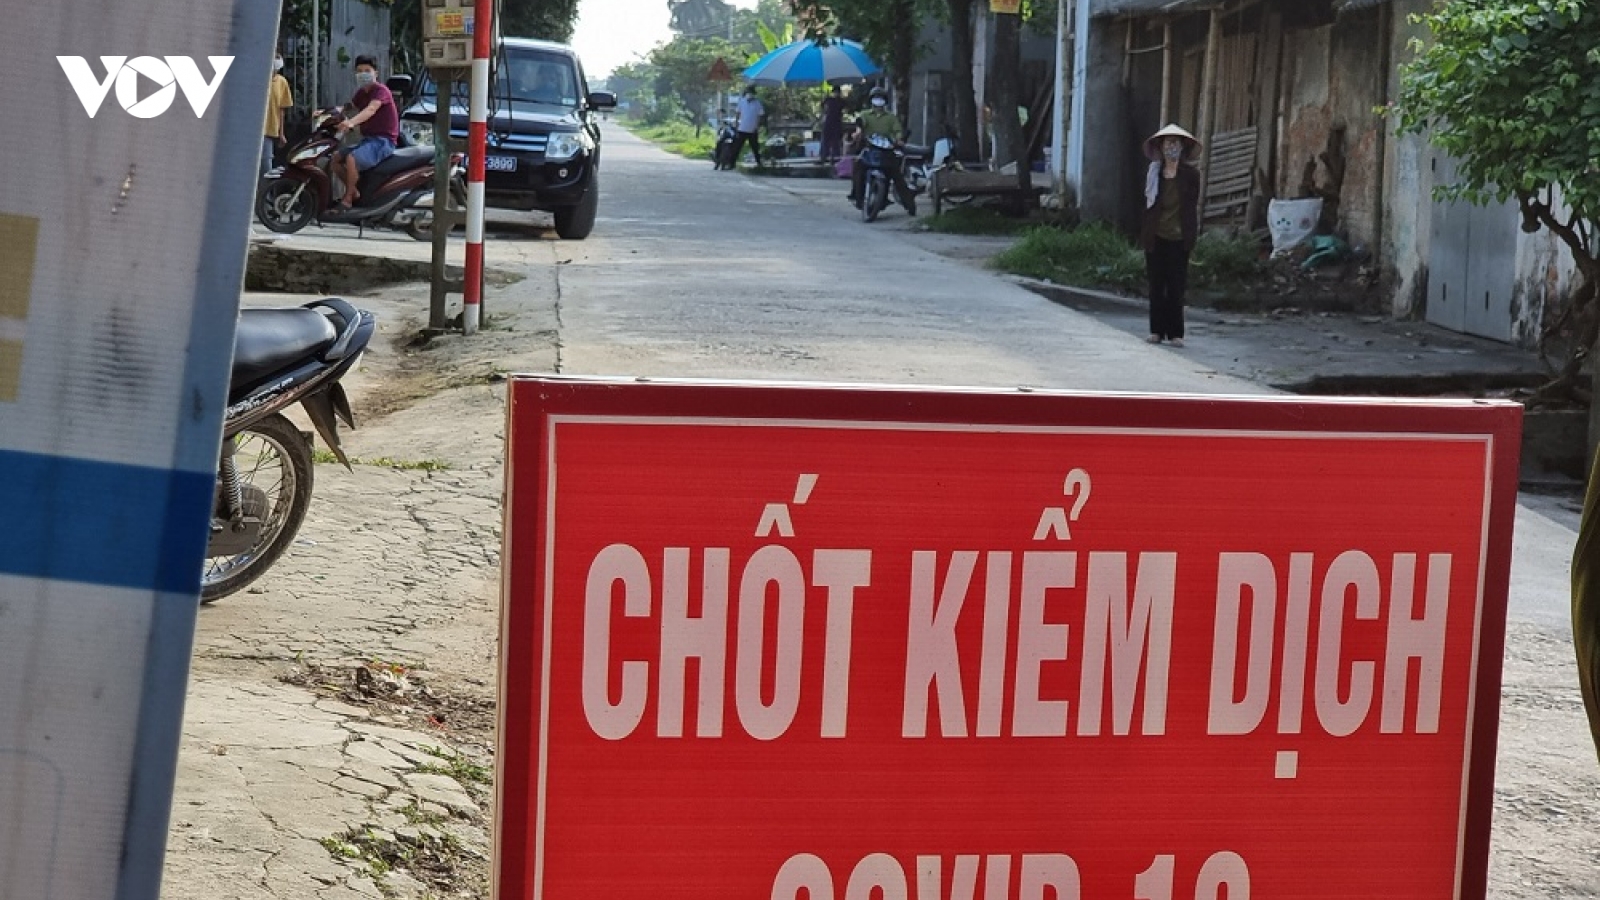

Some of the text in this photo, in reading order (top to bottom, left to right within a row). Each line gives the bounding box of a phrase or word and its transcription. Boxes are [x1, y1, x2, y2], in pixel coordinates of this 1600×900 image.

[582, 468, 1452, 779] CHỐT KIỂM DỊCH
